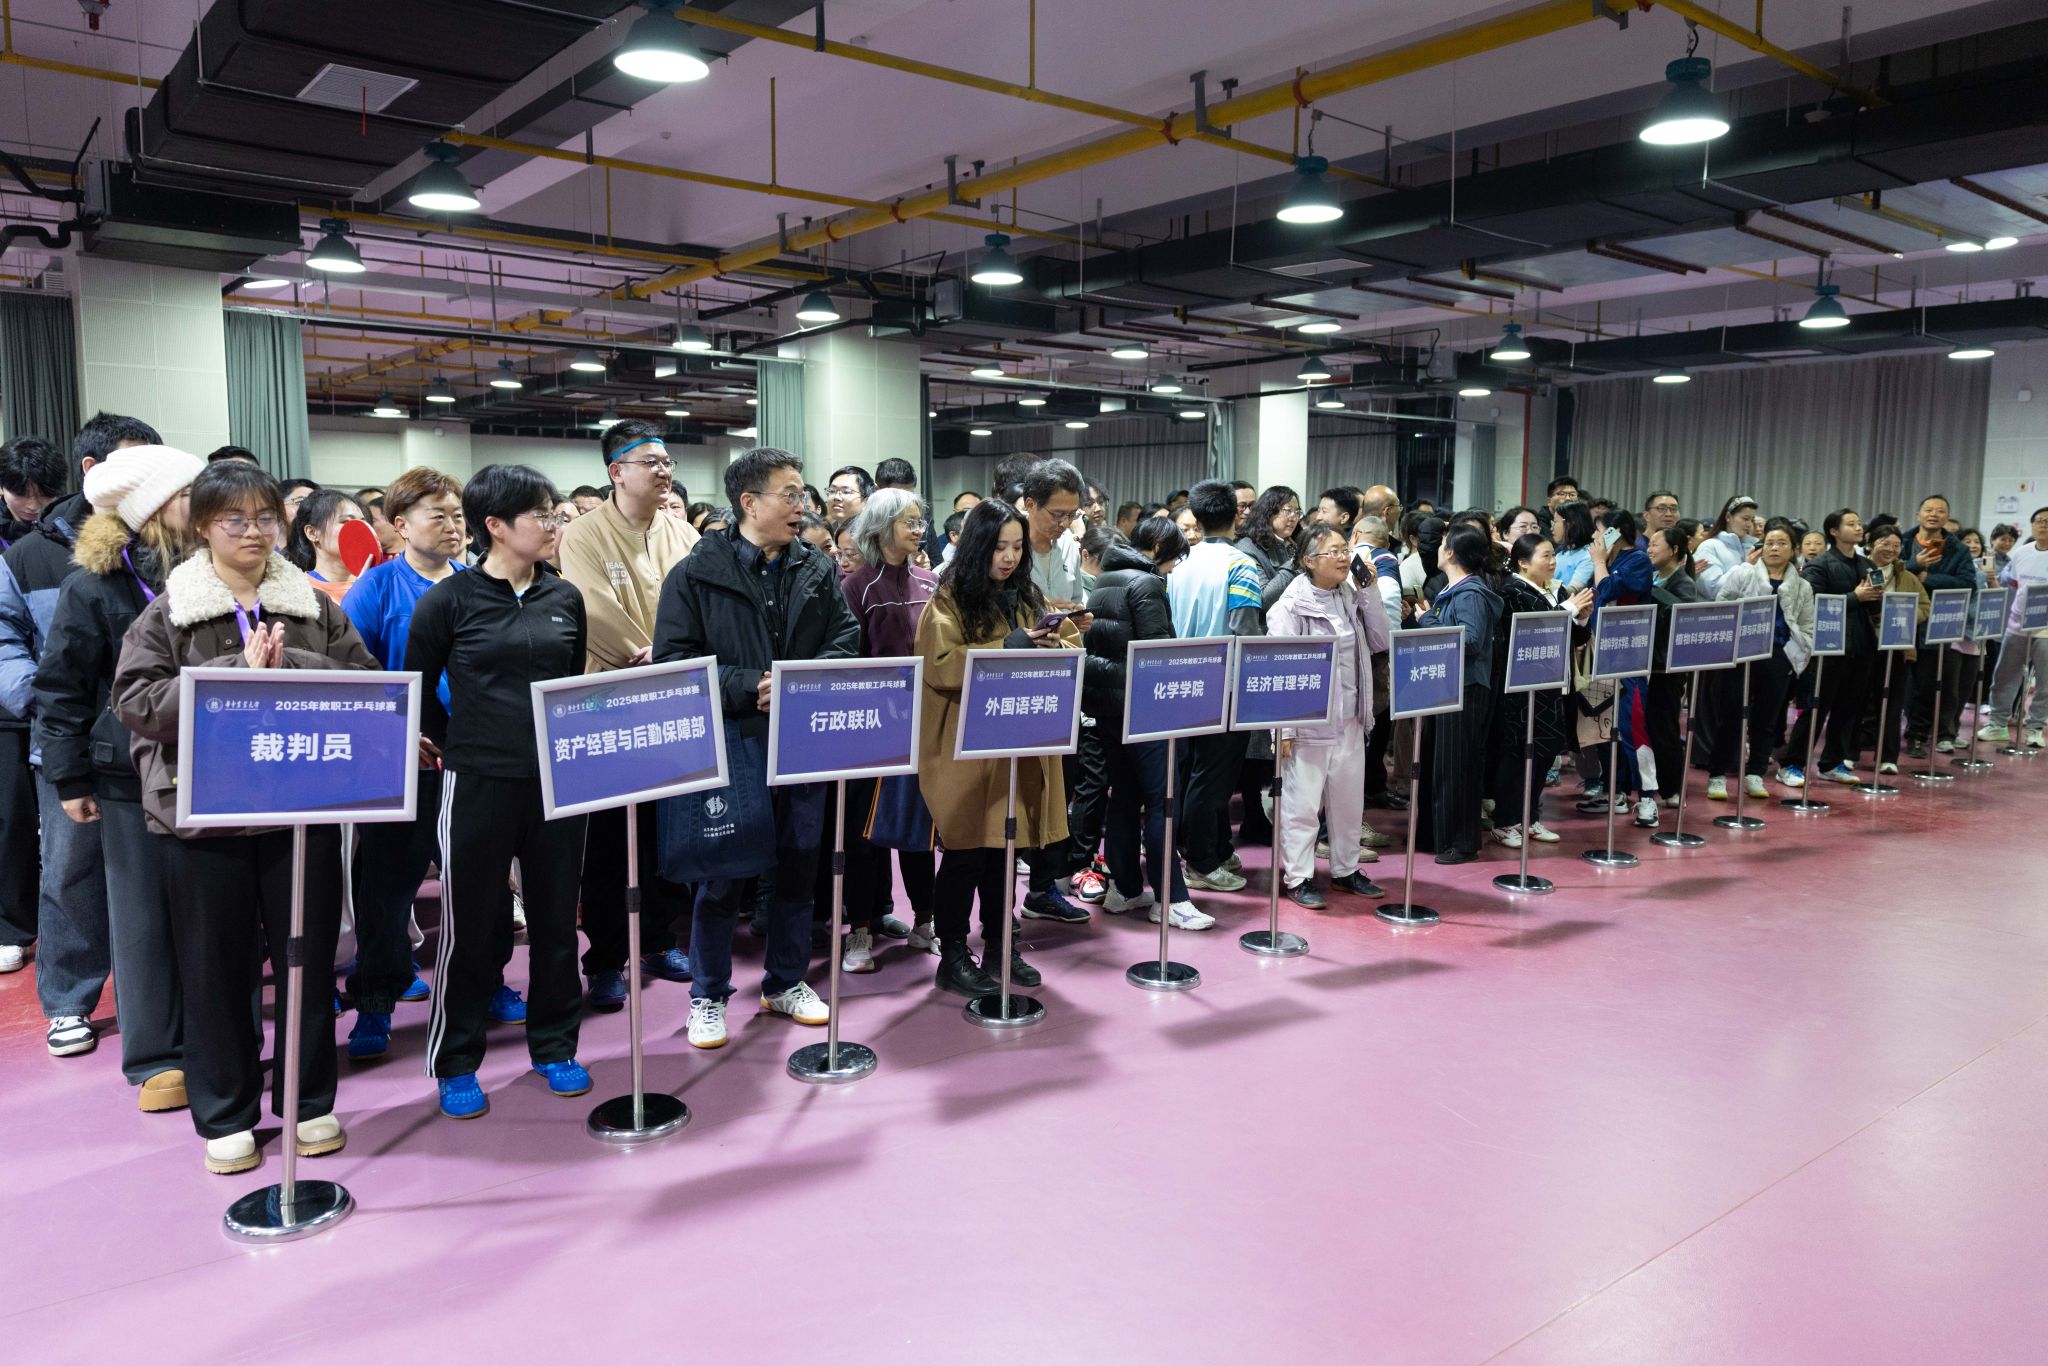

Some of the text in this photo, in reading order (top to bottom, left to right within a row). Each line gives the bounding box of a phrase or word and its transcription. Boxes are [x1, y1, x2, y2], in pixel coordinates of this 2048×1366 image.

[1516, 645, 1561, 661] 生科信息联队
[1010, 669, 1072, 679] 2025年教职工乒乓球赛
[1245, 673, 1322, 692] 经济管理学院
[1410, 663, 1447, 682] 水产学院
[830, 679, 907, 691] 2025年教职工乒乓球赛
[1153, 679, 1205, 700] 化学学院
[275, 700, 397, 712] 2025年教职工乒乓球赛
[606, 684, 700, 708] 2025年教职工乒乓球赛
[984, 694, 1059, 717] 外国语学院
[810, 708, 882, 733] 行政联队
[250, 732, 353, 763] 裁判员
[554, 715, 706, 763] 资产经营与后勤保障部
